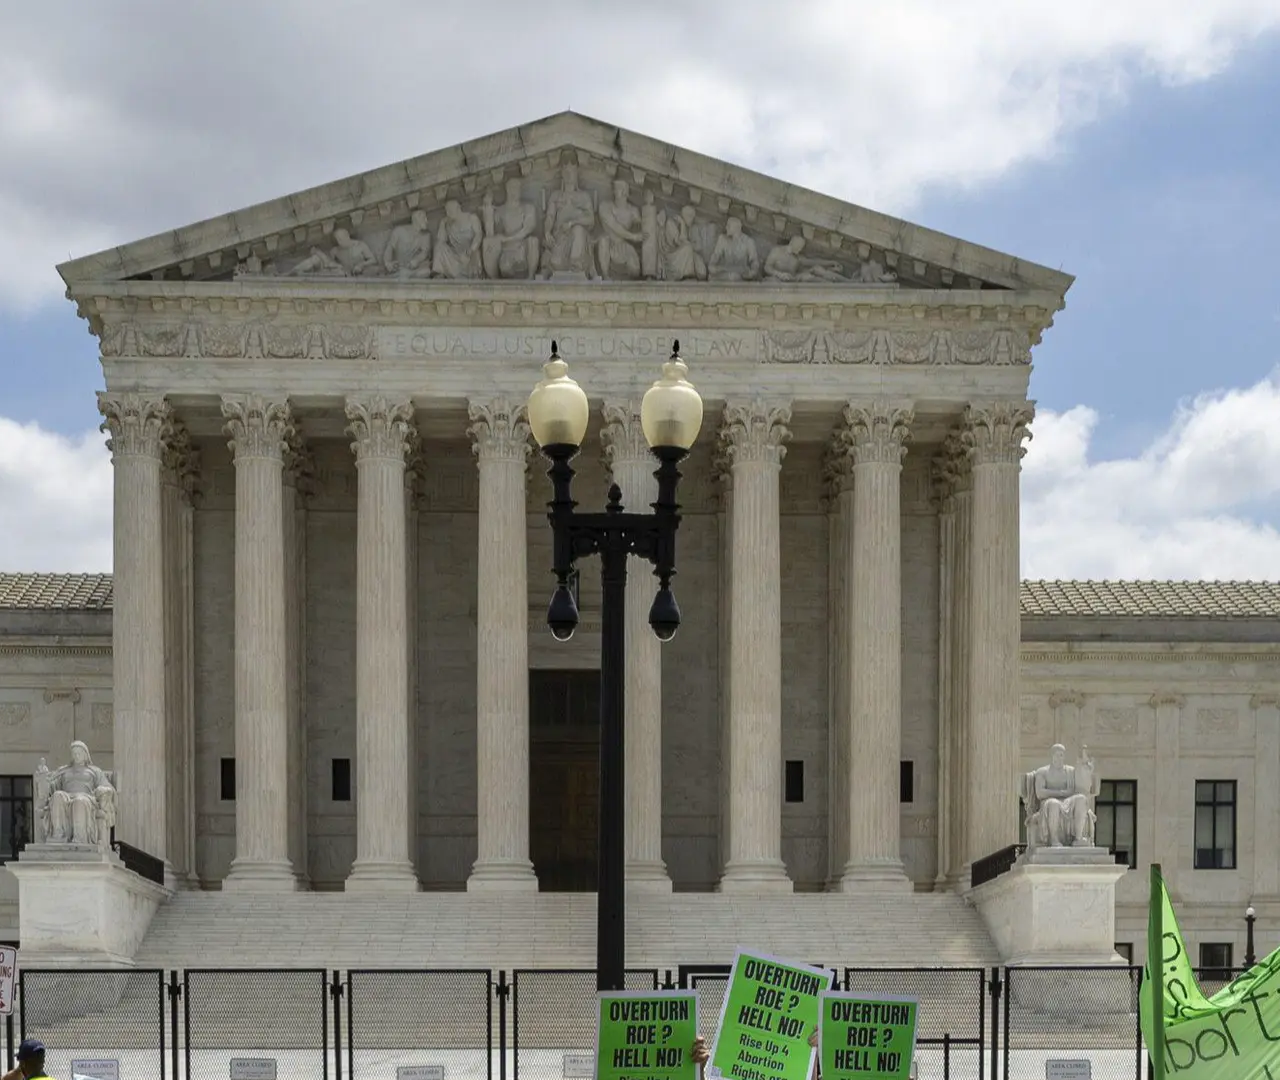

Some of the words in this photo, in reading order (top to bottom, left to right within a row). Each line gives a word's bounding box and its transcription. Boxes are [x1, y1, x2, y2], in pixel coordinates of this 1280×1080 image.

[394, 334, 480, 355] EQUAL
[694, 337, 743, 356] LAW
[744, 960, 820, 997] OVERTURN
[754, 986, 786, 1011] ROE
[610, 1001, 689, 1021] OVERTURN
[831, 1001, 910, 1025] OVERTURN
[738, 1005, 773, 1032] HELL
[777, 1015, 805, 1040] NO!
[626, 1025, 655, 1045] ROE
[739, 1033, 763, 1051] Rise
[764, 1040, 780, 1057] Up
[782, 1045, 790, 1057] 4
[847, 1027, 877, 1047] ROE
[613, 1048, 650, 1067] HELL
[656, 1048, 683, 1067] NO!
[737, 1050, 784, 1071] Abortion
[834, 1050, 871, 1071] HELL
[877, 1052, 901, 1073] NO!
